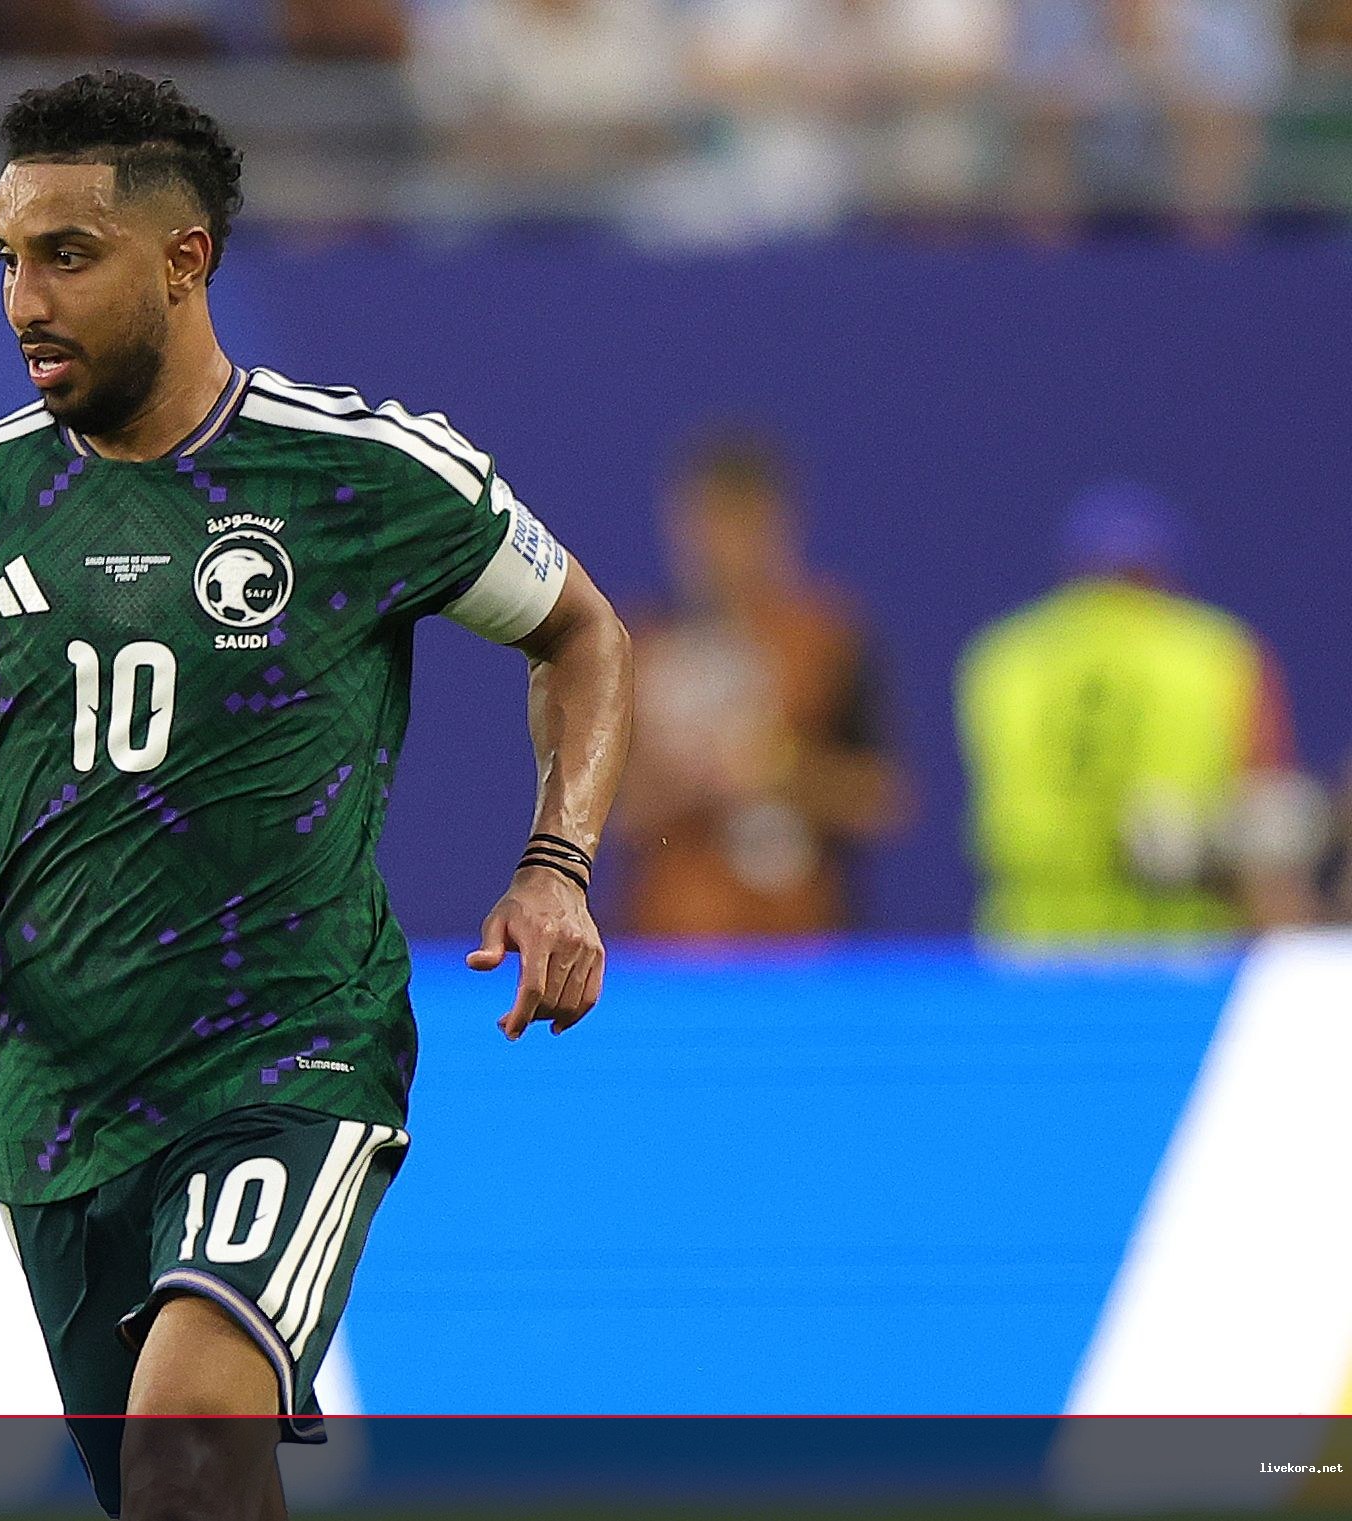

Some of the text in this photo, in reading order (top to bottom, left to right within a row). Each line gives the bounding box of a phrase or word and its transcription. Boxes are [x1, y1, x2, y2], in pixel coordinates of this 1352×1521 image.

[207, 513, 285, 534] السعودية
[245, 588, 273, 599] SAFF
[214, 634, 268, 650] SAUDI
[67, 640, 177, 773] 10
[179, 1157, 288, 1263] 10
